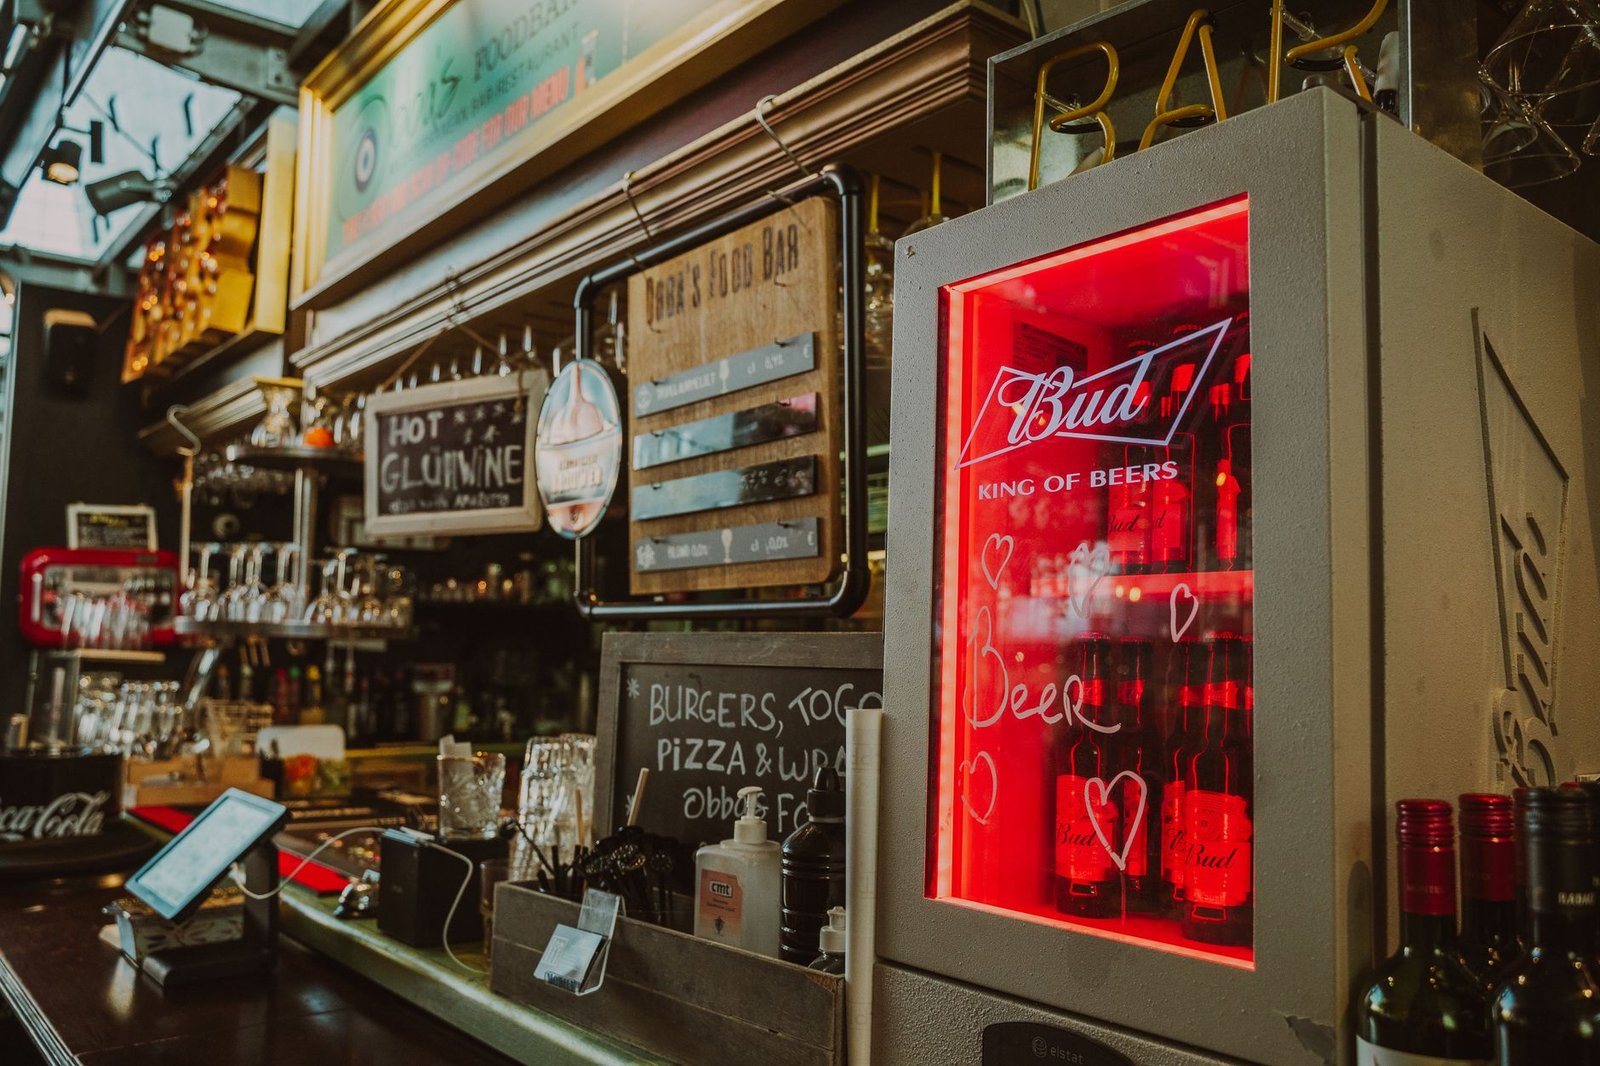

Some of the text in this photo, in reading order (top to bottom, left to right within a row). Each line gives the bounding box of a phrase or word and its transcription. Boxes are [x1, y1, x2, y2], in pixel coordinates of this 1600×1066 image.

[708, 243, 753, 298] FOOD
[762, 224, 799, 281] BAR
[997, 352, 1154, 444] Bud
[388, 410, 444, 447] HOT
[978, 460, 1179, 501] KING OF BEERS
[650, 683, 784, 739] BURGERS,
[756, 742, 773, 777] &
[1186, 843, 1238, 869] Bud
[711, 882, 730, 896] cmt
[1050, 1046, 1084, 1065] elstat
